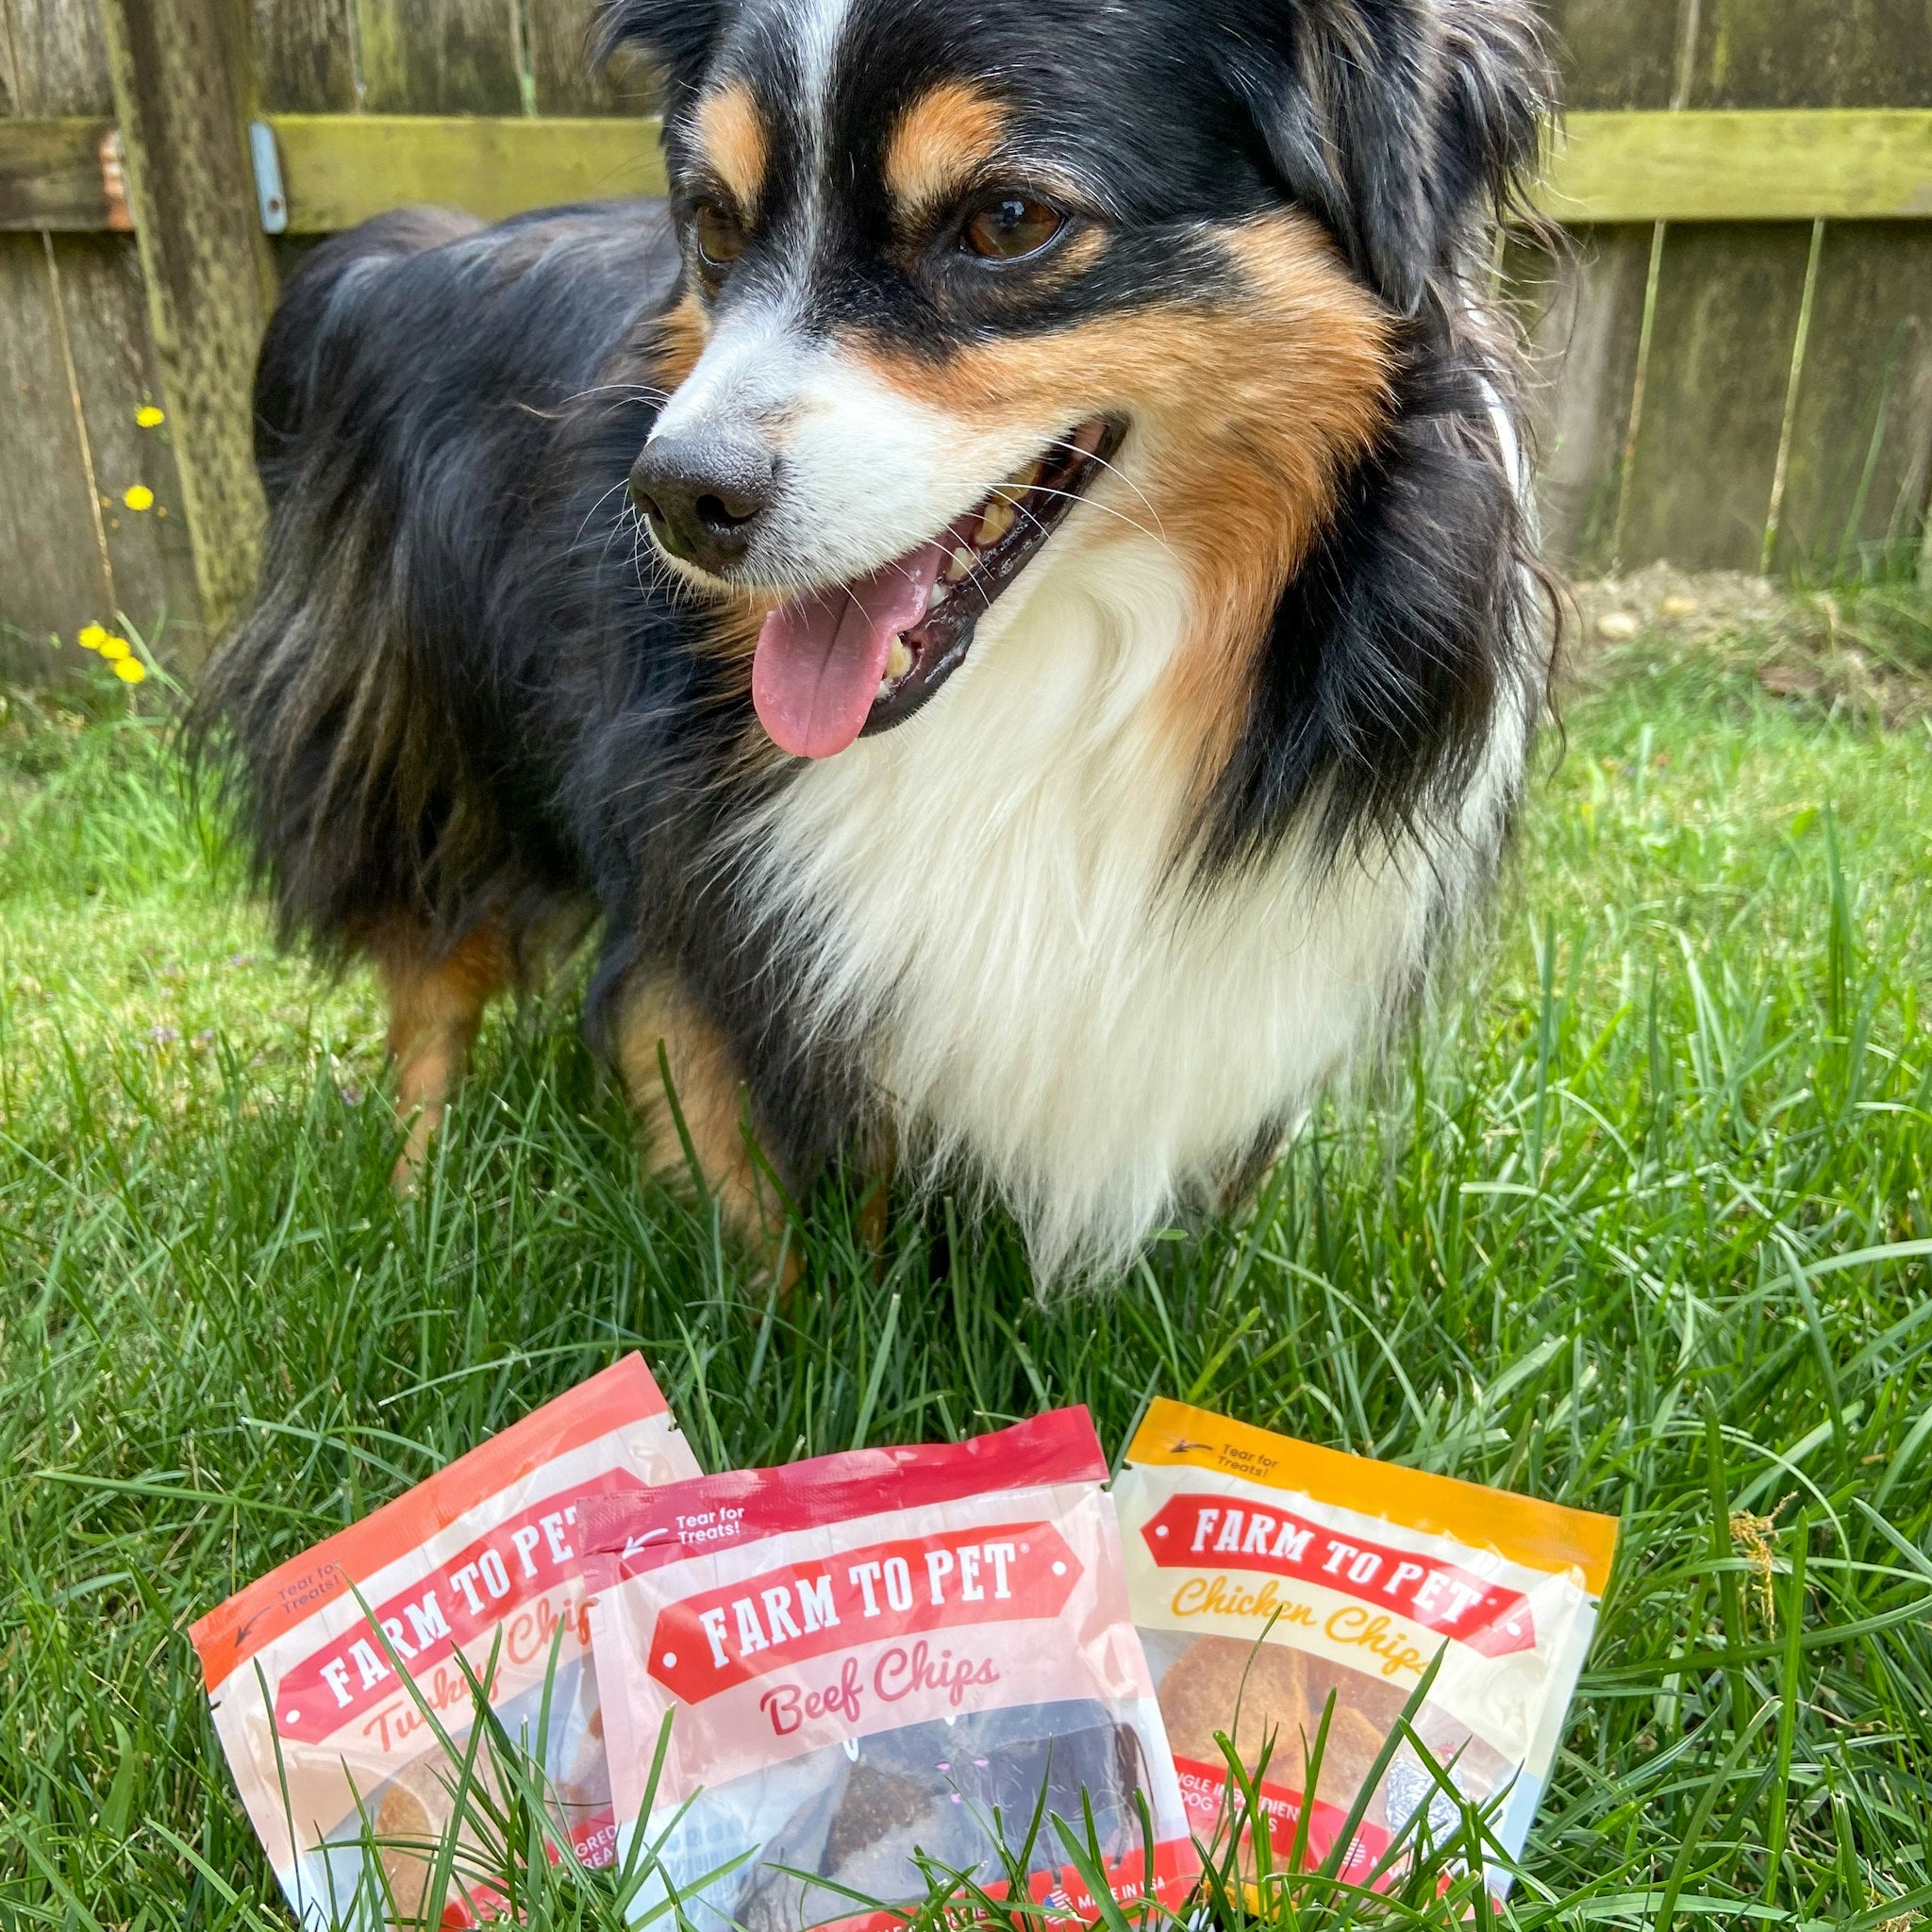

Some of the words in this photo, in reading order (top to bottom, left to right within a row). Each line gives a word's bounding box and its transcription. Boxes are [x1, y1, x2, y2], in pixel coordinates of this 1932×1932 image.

[1218, 1456, 1269, 1477] Treats!
[1224, 1443, 1255, 1461] Tear
[1257, 1454, 1278, 1468] for
[675, 1511, 717, 1529] Tear
[720, 1507, 744, 1521] for
[677, 1520, 740, 1544] Treats!
[1191, 1507, 1316, 1562] FARM
[1322, 1540, 1384, 1584] TO
[1382, 1561, 1484, 1624] PET
[278, 1574, 313, 1601] Tear
[282, 1574, 340, 1614] Treats!
[699, 1574, 841, 1668] FARM
[850, 1557, 913, 1618] TO
[924, 1542, 1017, 1606] PET
[1171, 1575, 1317, 1626] Chicken
[319, 1590, 452, 1709] FARM
[449, 1548, 511, 1617] TO
[508, 1596, 600, 1665] Chip
[759, 1657, 863, 1737] Beef
[874, 1640, 1001, 1707] Chips
[1076, 1887, 1120, 1909] ME
[1122, 1882, 1138, 1899] IN
